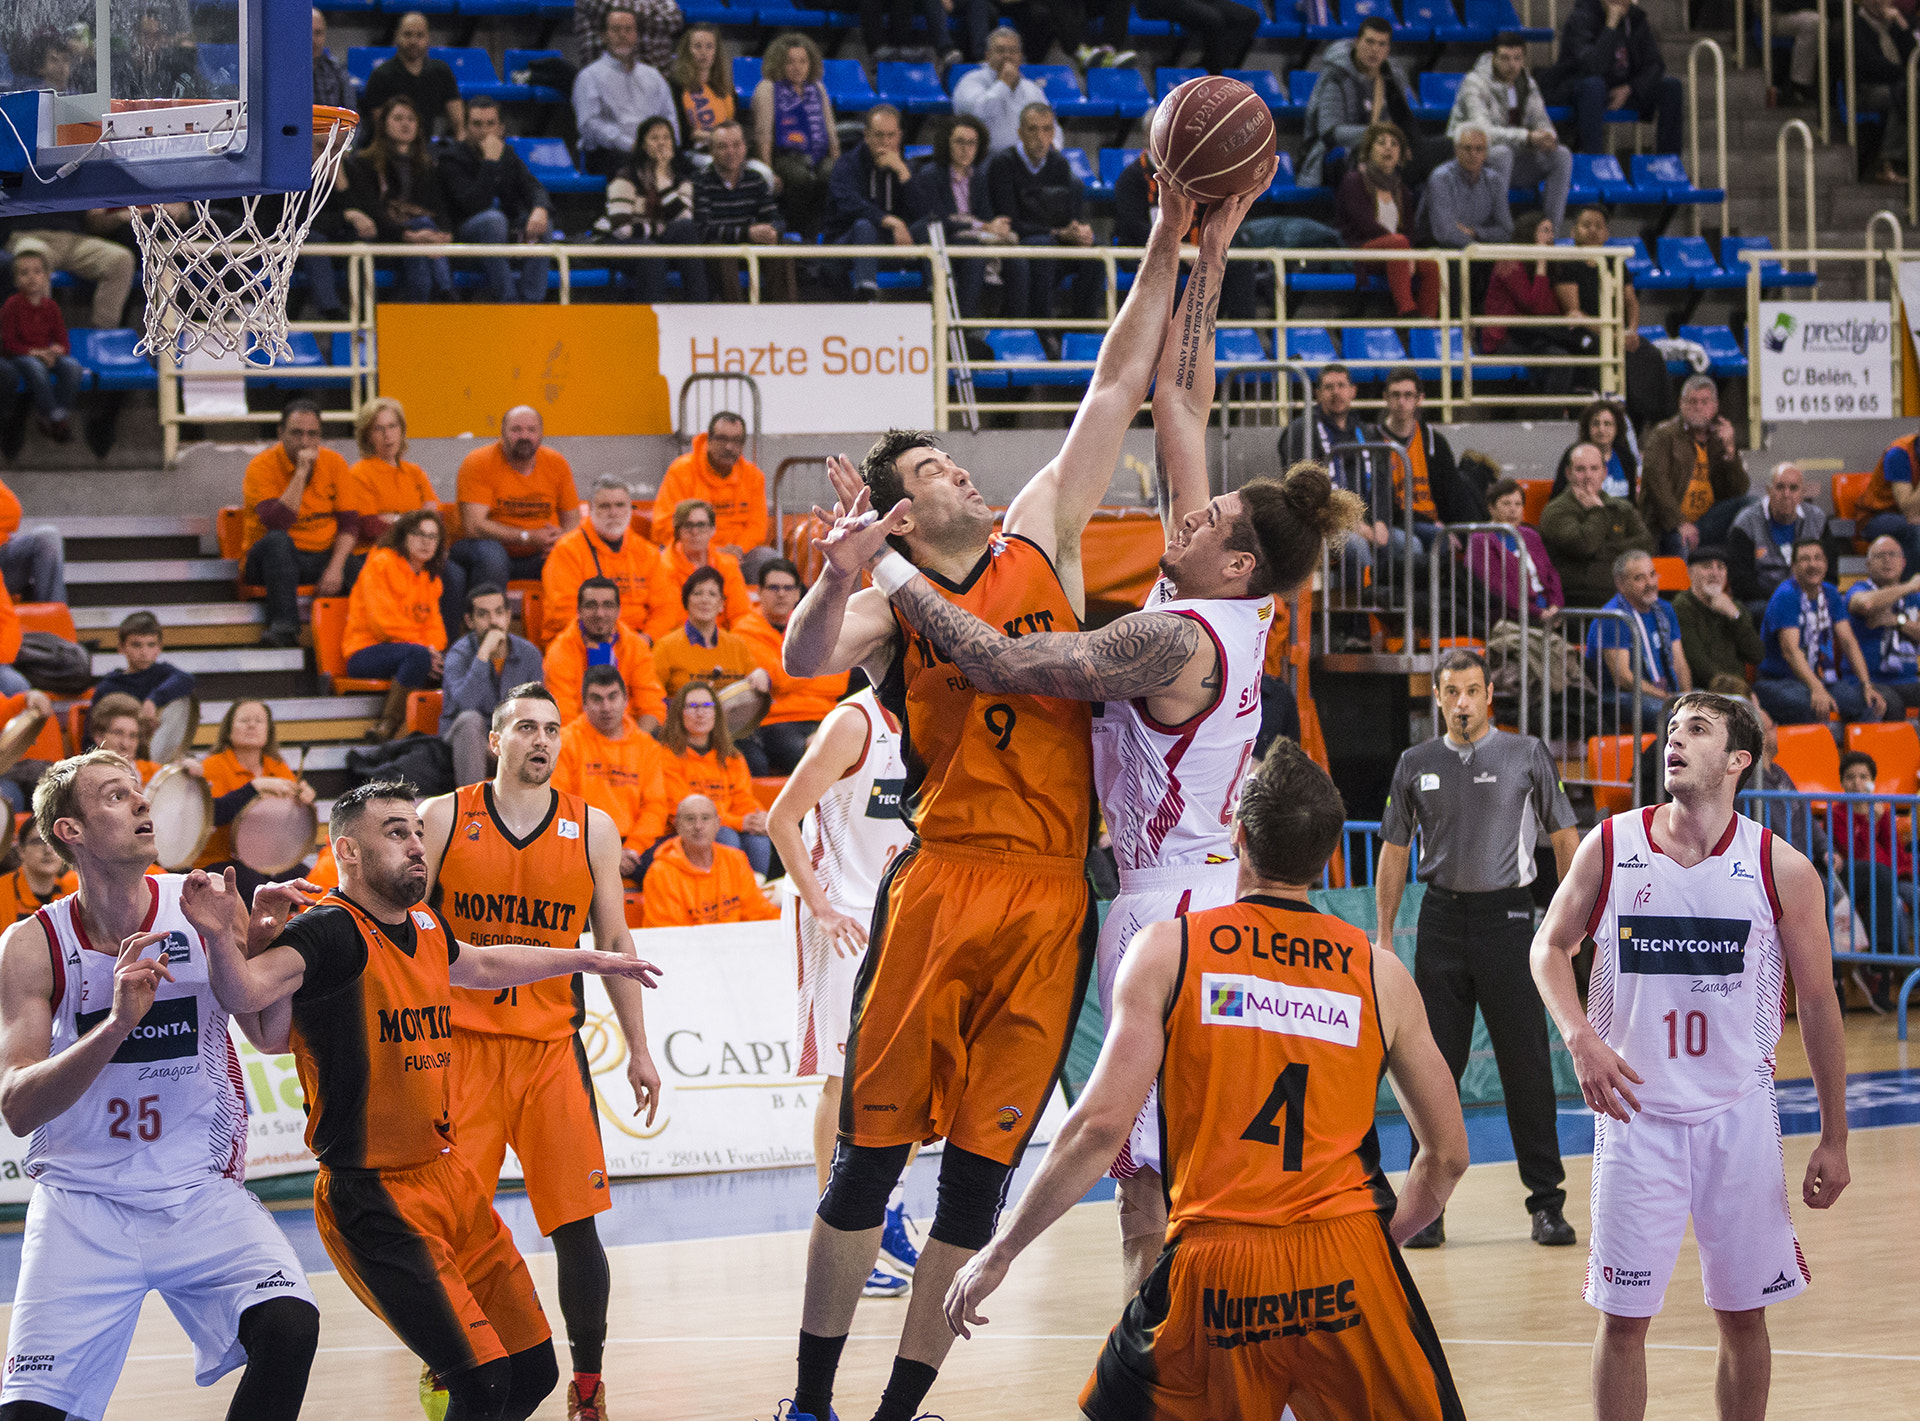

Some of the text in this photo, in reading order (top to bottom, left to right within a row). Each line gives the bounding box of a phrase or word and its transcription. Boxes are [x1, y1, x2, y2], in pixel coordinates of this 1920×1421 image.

[1185, 81, 1248, 136] SPALDING
[1197, 275, 1208, 298] WHO
[1803, 318, 1889, 355] prestigio
[690, 335, 930, 376] Hazte Socio
[1185, 370, 1195, 391] GOD
[1863, 368, 1870, 384] 1
[1776, 394, 1879, 412] 91 615 99 65
[984, 703, 1017, 751] 9
[1617, 861, 1649, 869] MERCURY
[454, 891, 576, 932] MONTAKIT
[1209, 924, 1354, 975] O'LEARY
[1246, 991, 1350, 1029] NAUTALIA
[1662, 1008, 1710, 1060] 10
[106, 1093, 163, 1143] 25
[1238, 1061, 1310, 1172] 4
[255, 1280, 296, 1290] MERCURY
[1614, 1277, 1651, 1287] DEPORTE
[1615, 1267, 1652, 1280] Zaragoza
[1761, 1278, 1797, 1296] MERCURY
[1203, 1279, 1356, 1330] NUTRYTEC
